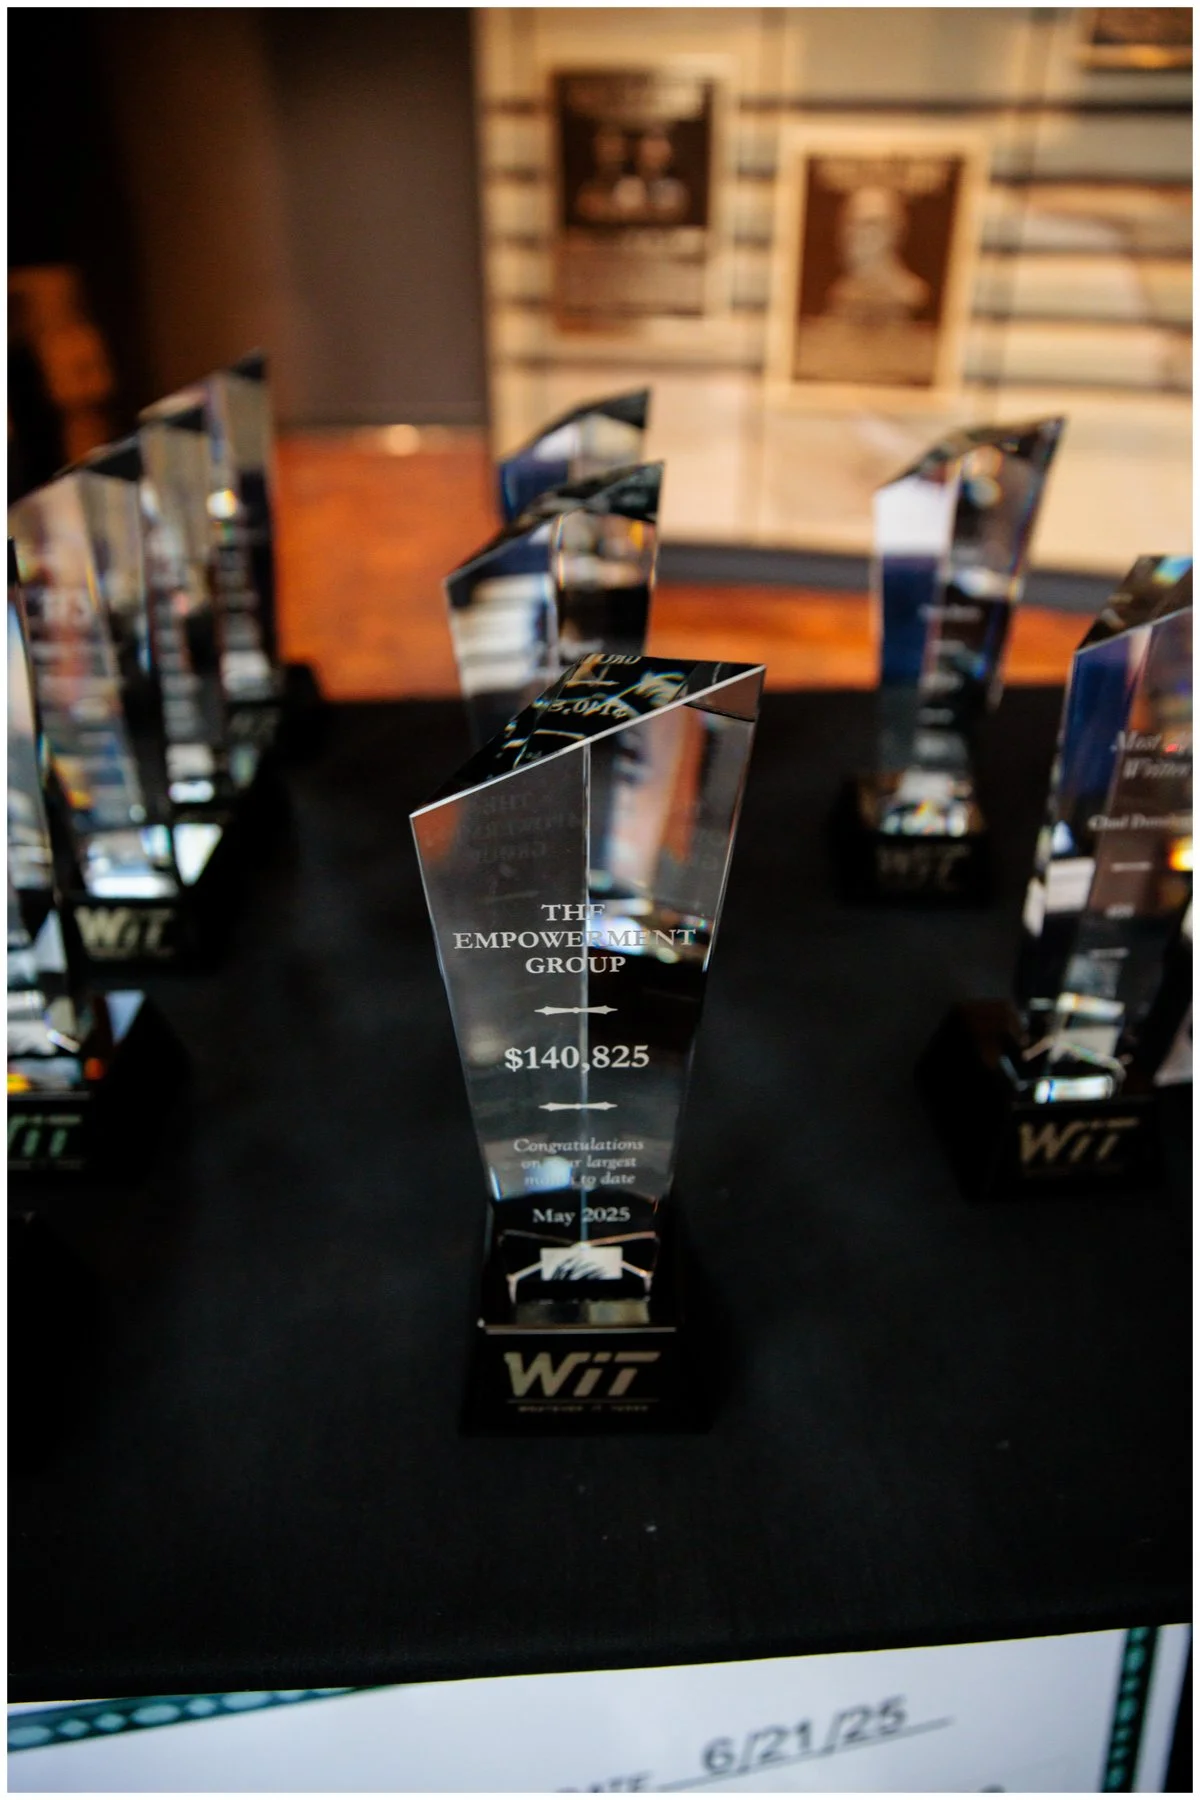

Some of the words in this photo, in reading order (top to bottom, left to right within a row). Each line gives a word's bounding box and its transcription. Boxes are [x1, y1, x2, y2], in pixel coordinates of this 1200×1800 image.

[453, 929, 697, 949] EMPOWERMENT
[525, 956, 627, 974] GROUP
[504, 1045, 650, 1074] $140,825
[513, 1137, 644, 1154] Congratulations
[1017, 1116, 1140, 1165] WiT
[586, 1155, 637, 1170] largest
[600, 1170, 636, 1186] date
[532, 1207, 576, 1227] May
[581, 1206, 631, 1222] 2025
[503, 1352, 661, 1397] WiT
[701, 1694, 907, 1775] 6/21/25
